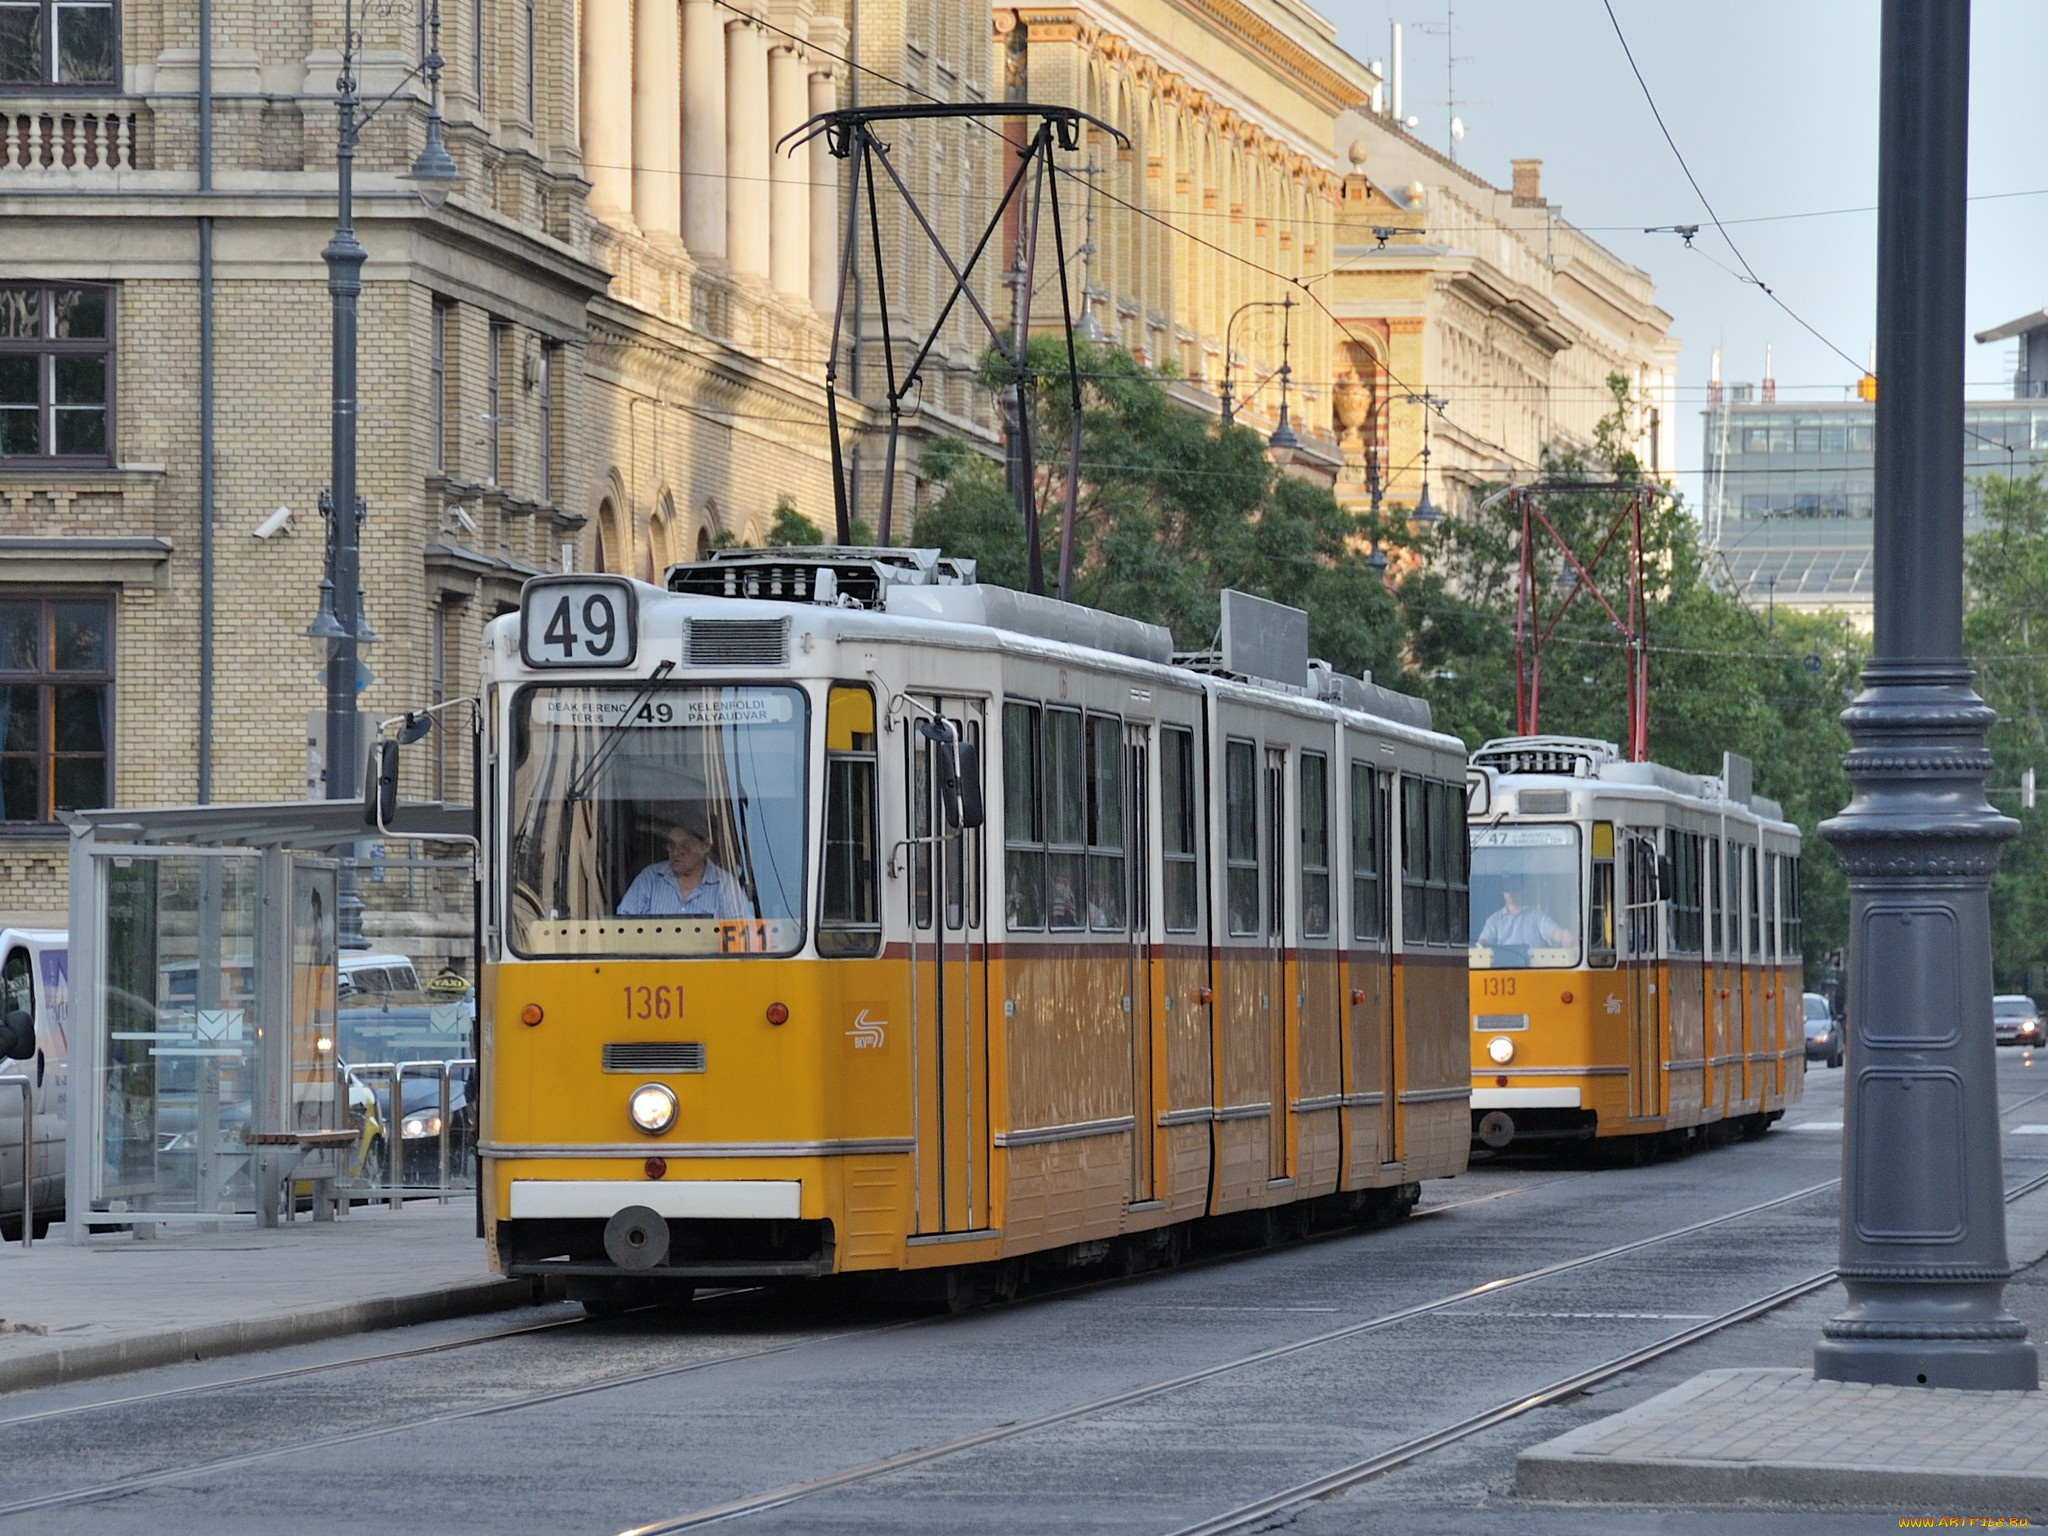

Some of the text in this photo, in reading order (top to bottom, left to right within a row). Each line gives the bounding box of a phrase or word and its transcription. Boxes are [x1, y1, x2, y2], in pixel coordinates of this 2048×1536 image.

[543, 593, 616, 658] 49
[582, 703, 628, 713] FERENC
[635, 703, 673, 723] 49
[1489, 832, 1508, 845] 47
[722, 923, 768, 952] F11
[431, 978, 463, 988] TAXI
[1483, 977, 1516, 997] 1313
[623, 984, 685, 1020] 1361
